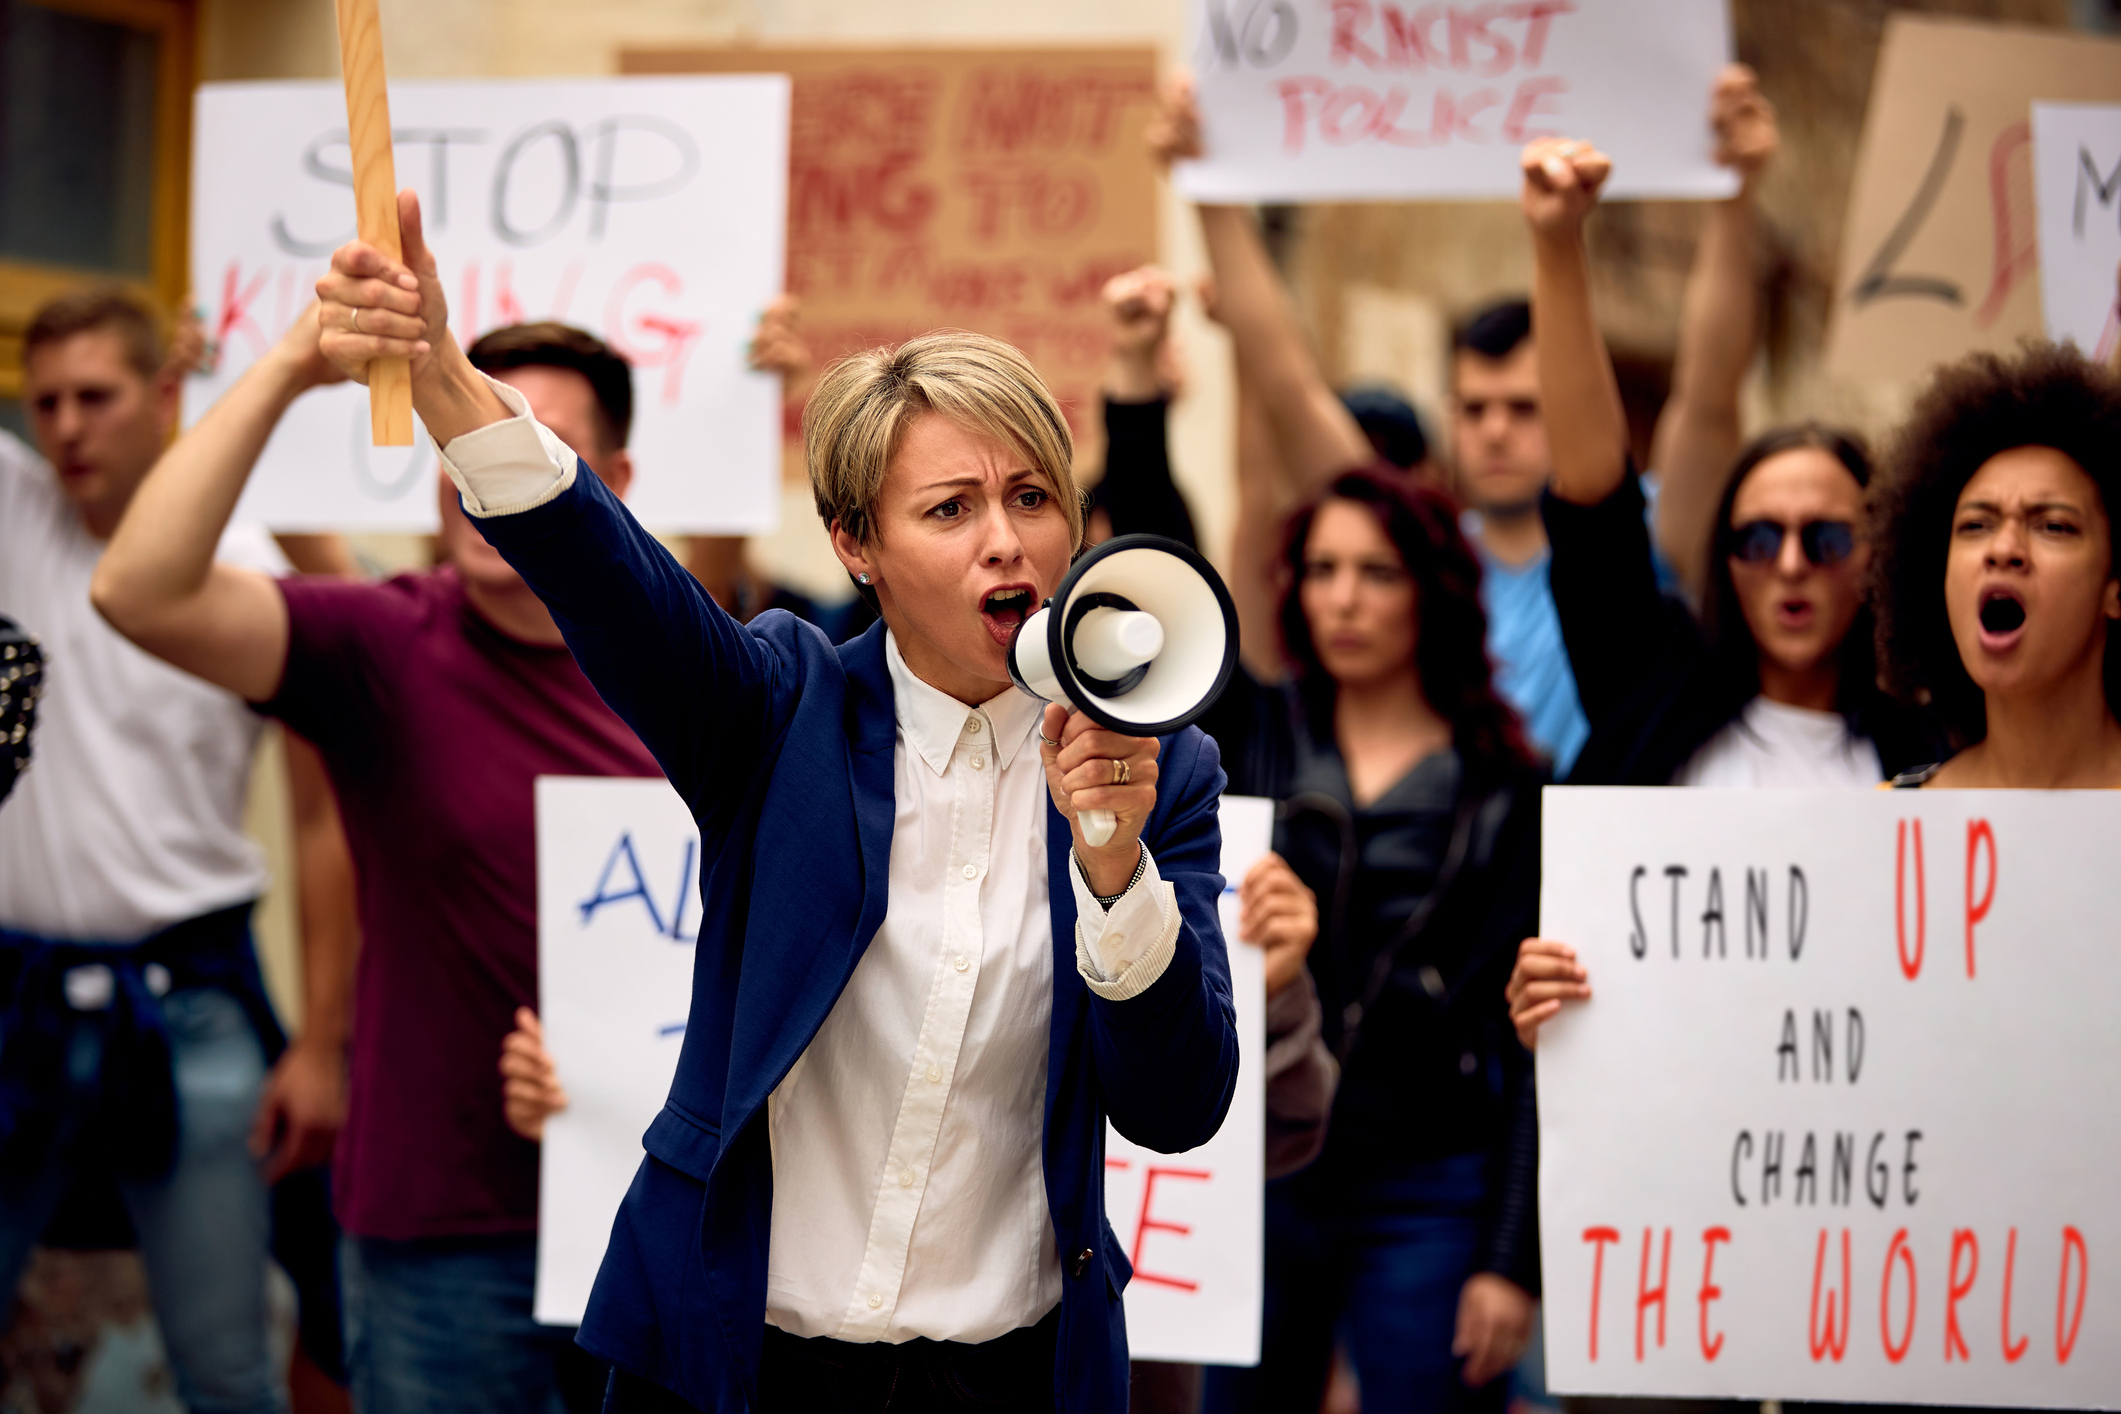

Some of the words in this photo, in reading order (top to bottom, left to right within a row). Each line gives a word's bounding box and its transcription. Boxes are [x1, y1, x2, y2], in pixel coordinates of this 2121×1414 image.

[1203, 0, 1300, 72] NO
[1328, 0, 1577, 79] RACIST
[1271, 76, 1569, 157] POLICE
[269, 113, 701, 259] STOP
[213, 256, 709, 407] KIING
[1629, 865, 1808, 962] STAND
[1895, 817, 1998, 981] UP
[1776, 1007, 1865, 1085] AND
[1731, 1130, 1923, 1210] CHANGE
[1581, 1226, 1732, 1363] THE
[1808, 1226, 2088, 1366] WORLD
